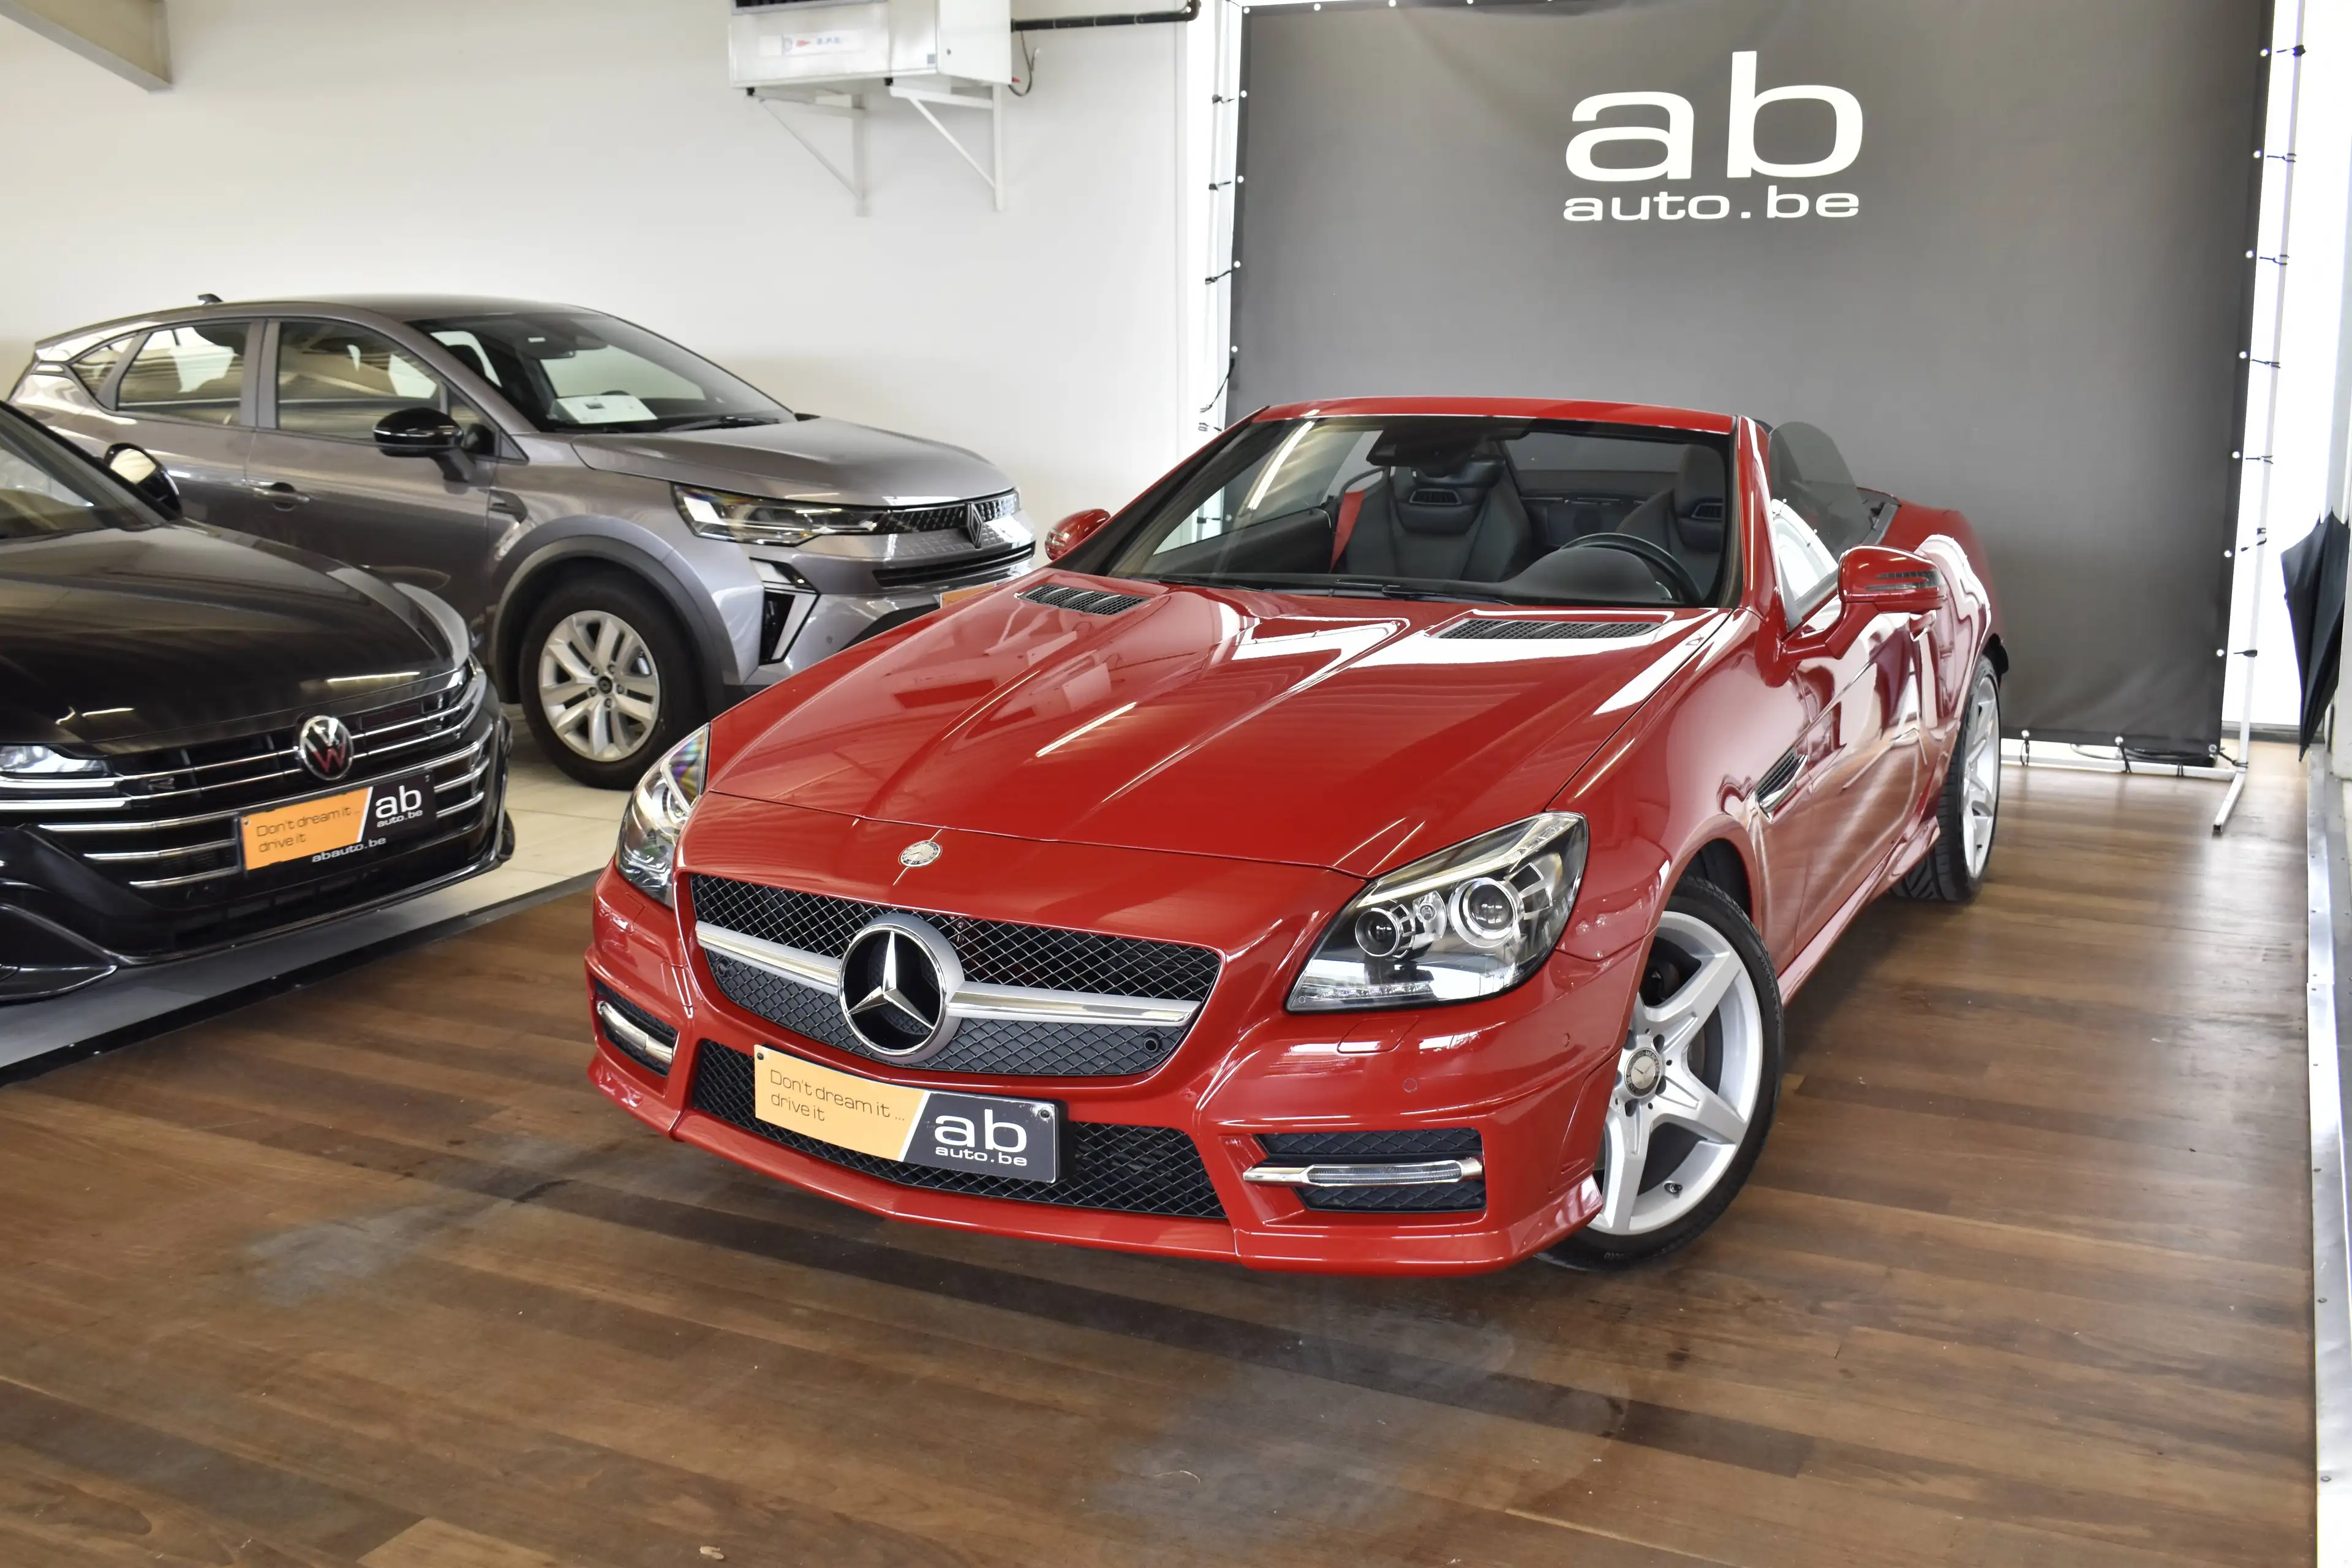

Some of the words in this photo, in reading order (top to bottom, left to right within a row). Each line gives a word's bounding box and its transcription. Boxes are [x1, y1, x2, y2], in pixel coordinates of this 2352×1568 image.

[1566, 51, 1863, 182] ab
[1563, 185, 1860, 222] auto.be
[375, 785, 422, 818] ab
[257, 820, 295, 837] Don't
[297, 810, 340, 827] dream
[342, 807, 351, 816] it
[377, 810, 423, 827] auto.be
[259, 837, 294, 852] drive
[296, 834, 306, 843] it
[312, 837, 386, 862] abauto.be
[771, 1069, 812, 1096] Don't
[815, 1087, 872, 1114] dream
[876, 1102, 890, 1118] it
[771, 1093, 810, 1117] drive
[813, 1105, 825, 1121] it
[935, 1109, 1027, 1153] ab
[935, 1147, 1027, 1166] auto.be
